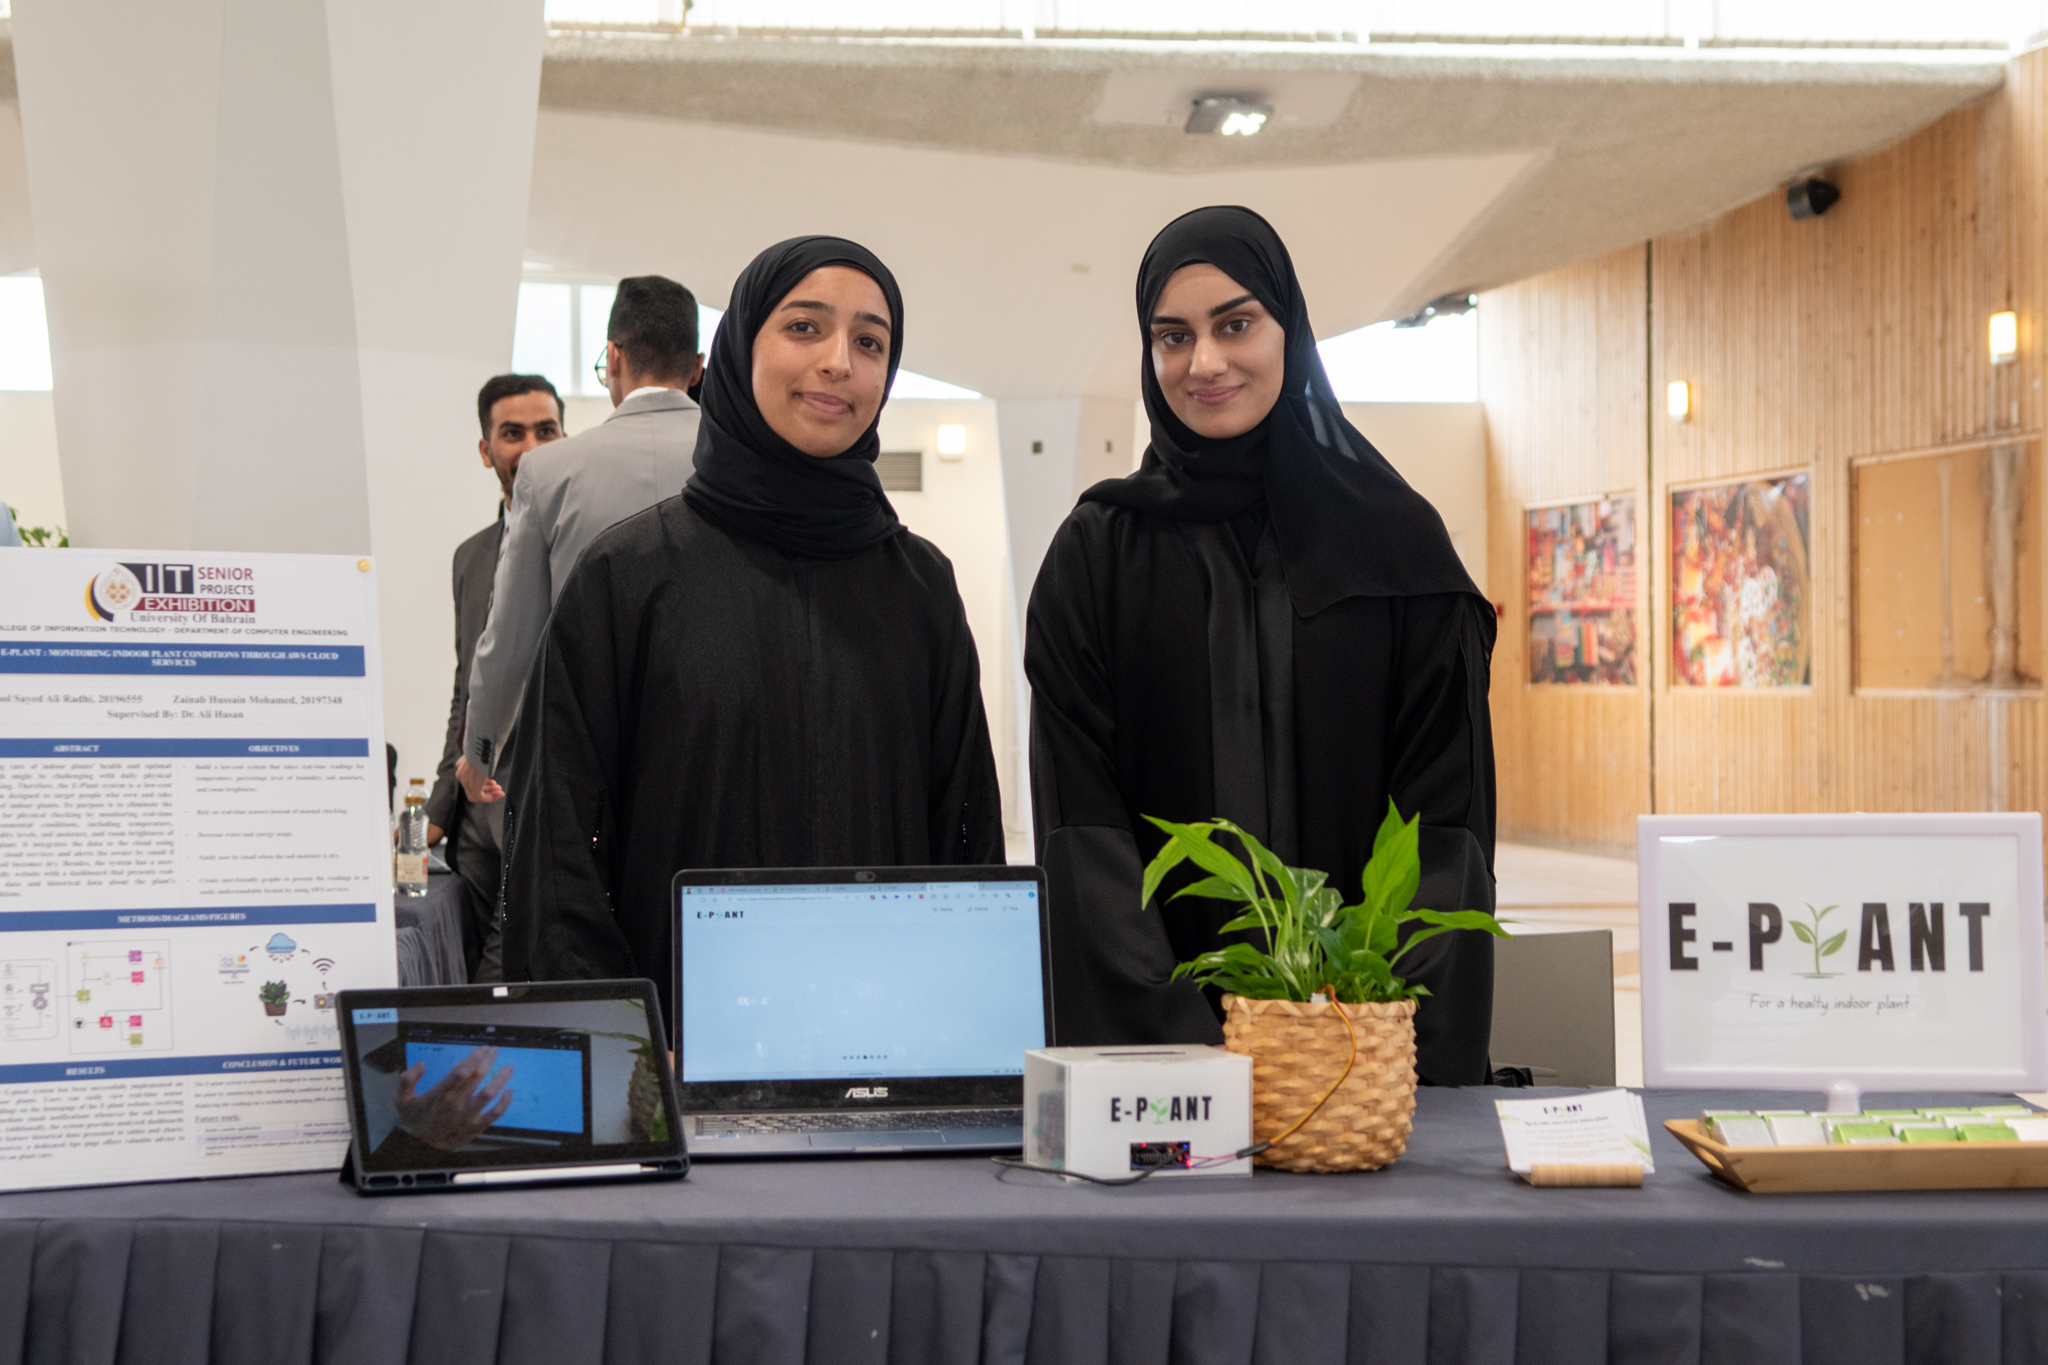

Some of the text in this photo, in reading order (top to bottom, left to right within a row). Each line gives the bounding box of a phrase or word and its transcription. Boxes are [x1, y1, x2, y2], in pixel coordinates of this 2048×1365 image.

[146, 565, 191, 592] IT
[198, 567, 254, 580] SENIOR
[200, 584, 254, 595] PROJECTS
[144, 598, 250, 611] EXHIBITION
[130, 612, 256, 625] University Of Bahrain
[49, 649, 111, 657] MONITORING
[112, 650, 150, 658] INDOOR
[150, 650, 182, 658] PLANT
[183, 650, 240, 659] CONDITIONS
[241, 651, 286, 659] THROUGH
[307, 652, 339, 660] CLOUD
[173, 695, 206, 703] Zainab
[208, 695, 246, 703] Hussain
[249, 695, 297, 703] Mohamed,
[106, 710, 160, 720] Supervised
[1749, 994, 1911, 1016] For a healty indoor plant
[322, 1056, 341, 1064] WOR
[845, 1087, 888, 1098] ASUS
